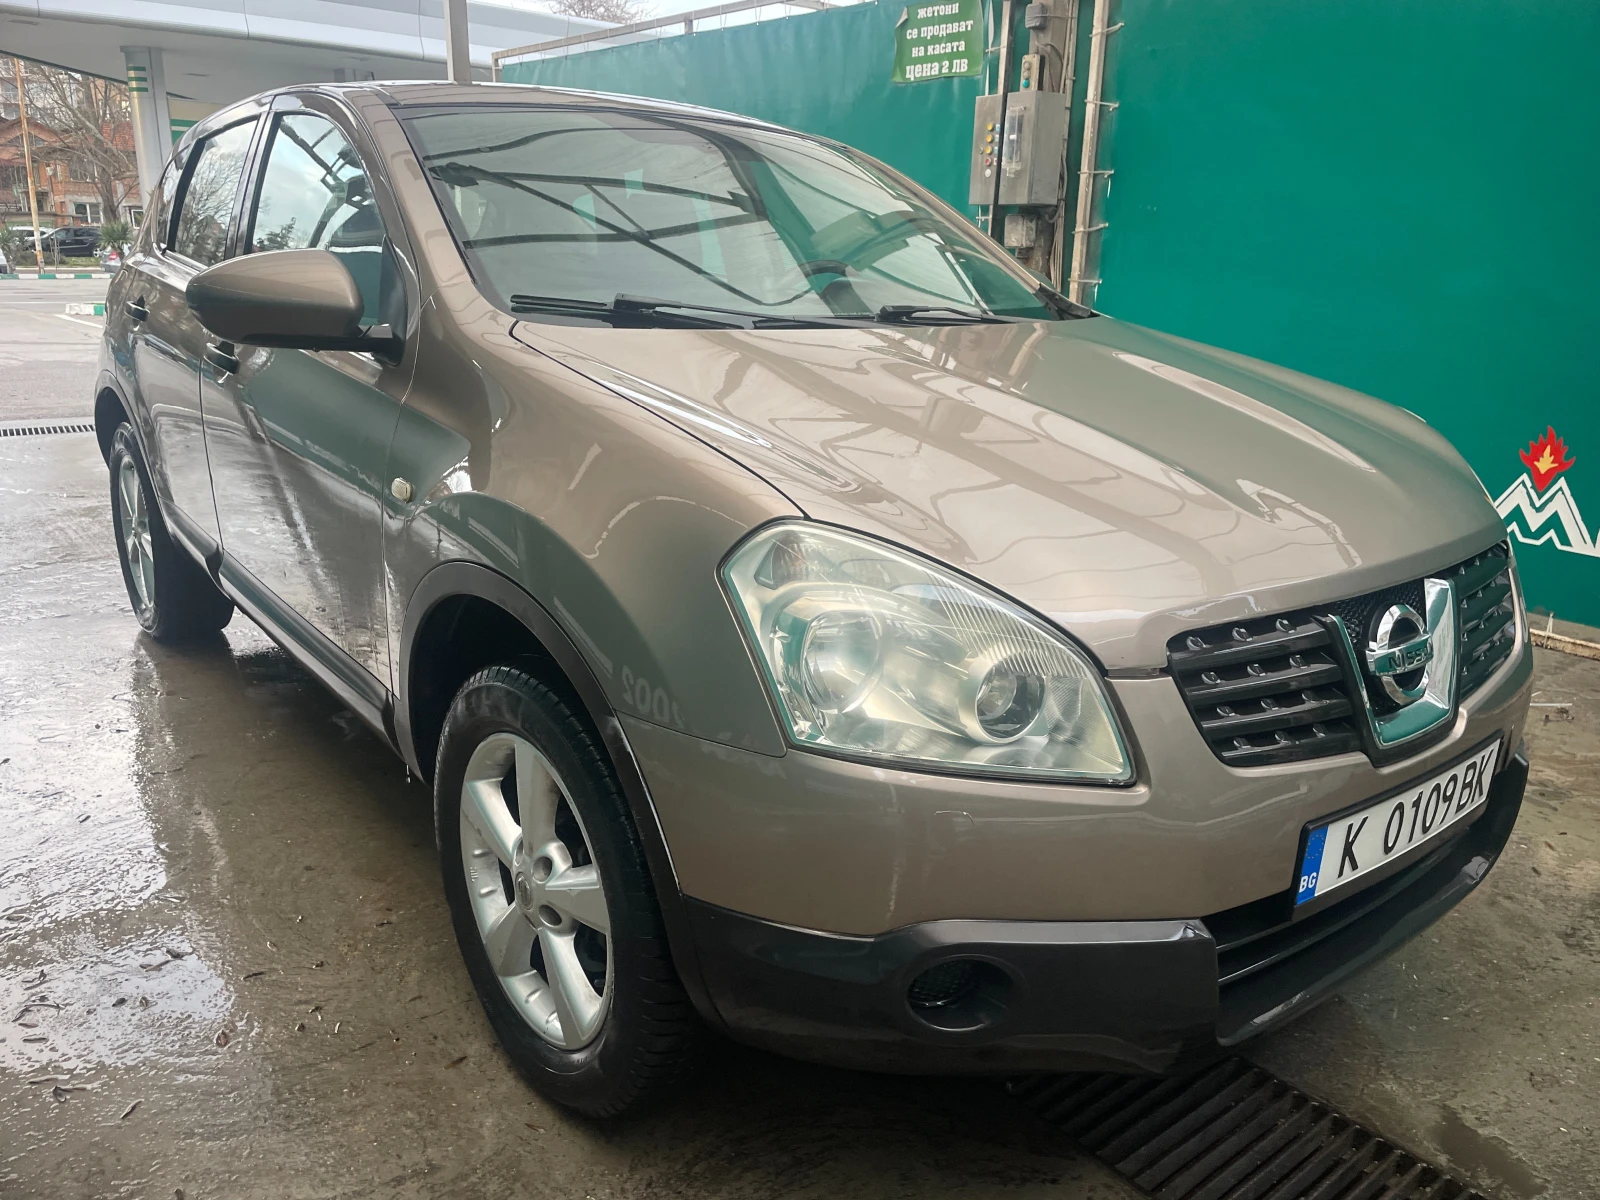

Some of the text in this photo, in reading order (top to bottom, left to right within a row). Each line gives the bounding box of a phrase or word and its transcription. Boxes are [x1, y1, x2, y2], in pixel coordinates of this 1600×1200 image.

[917, 3, 959, 19] жетони
[906, 20, 974, 39] се продават
[911, 40, 966, 57] на касата
[905, 62, 940, 81] цена
[941, 60, 950, 74] 2
[1336, 815, 1369, 879] K
[1298, 872, 1318, 893] BG
